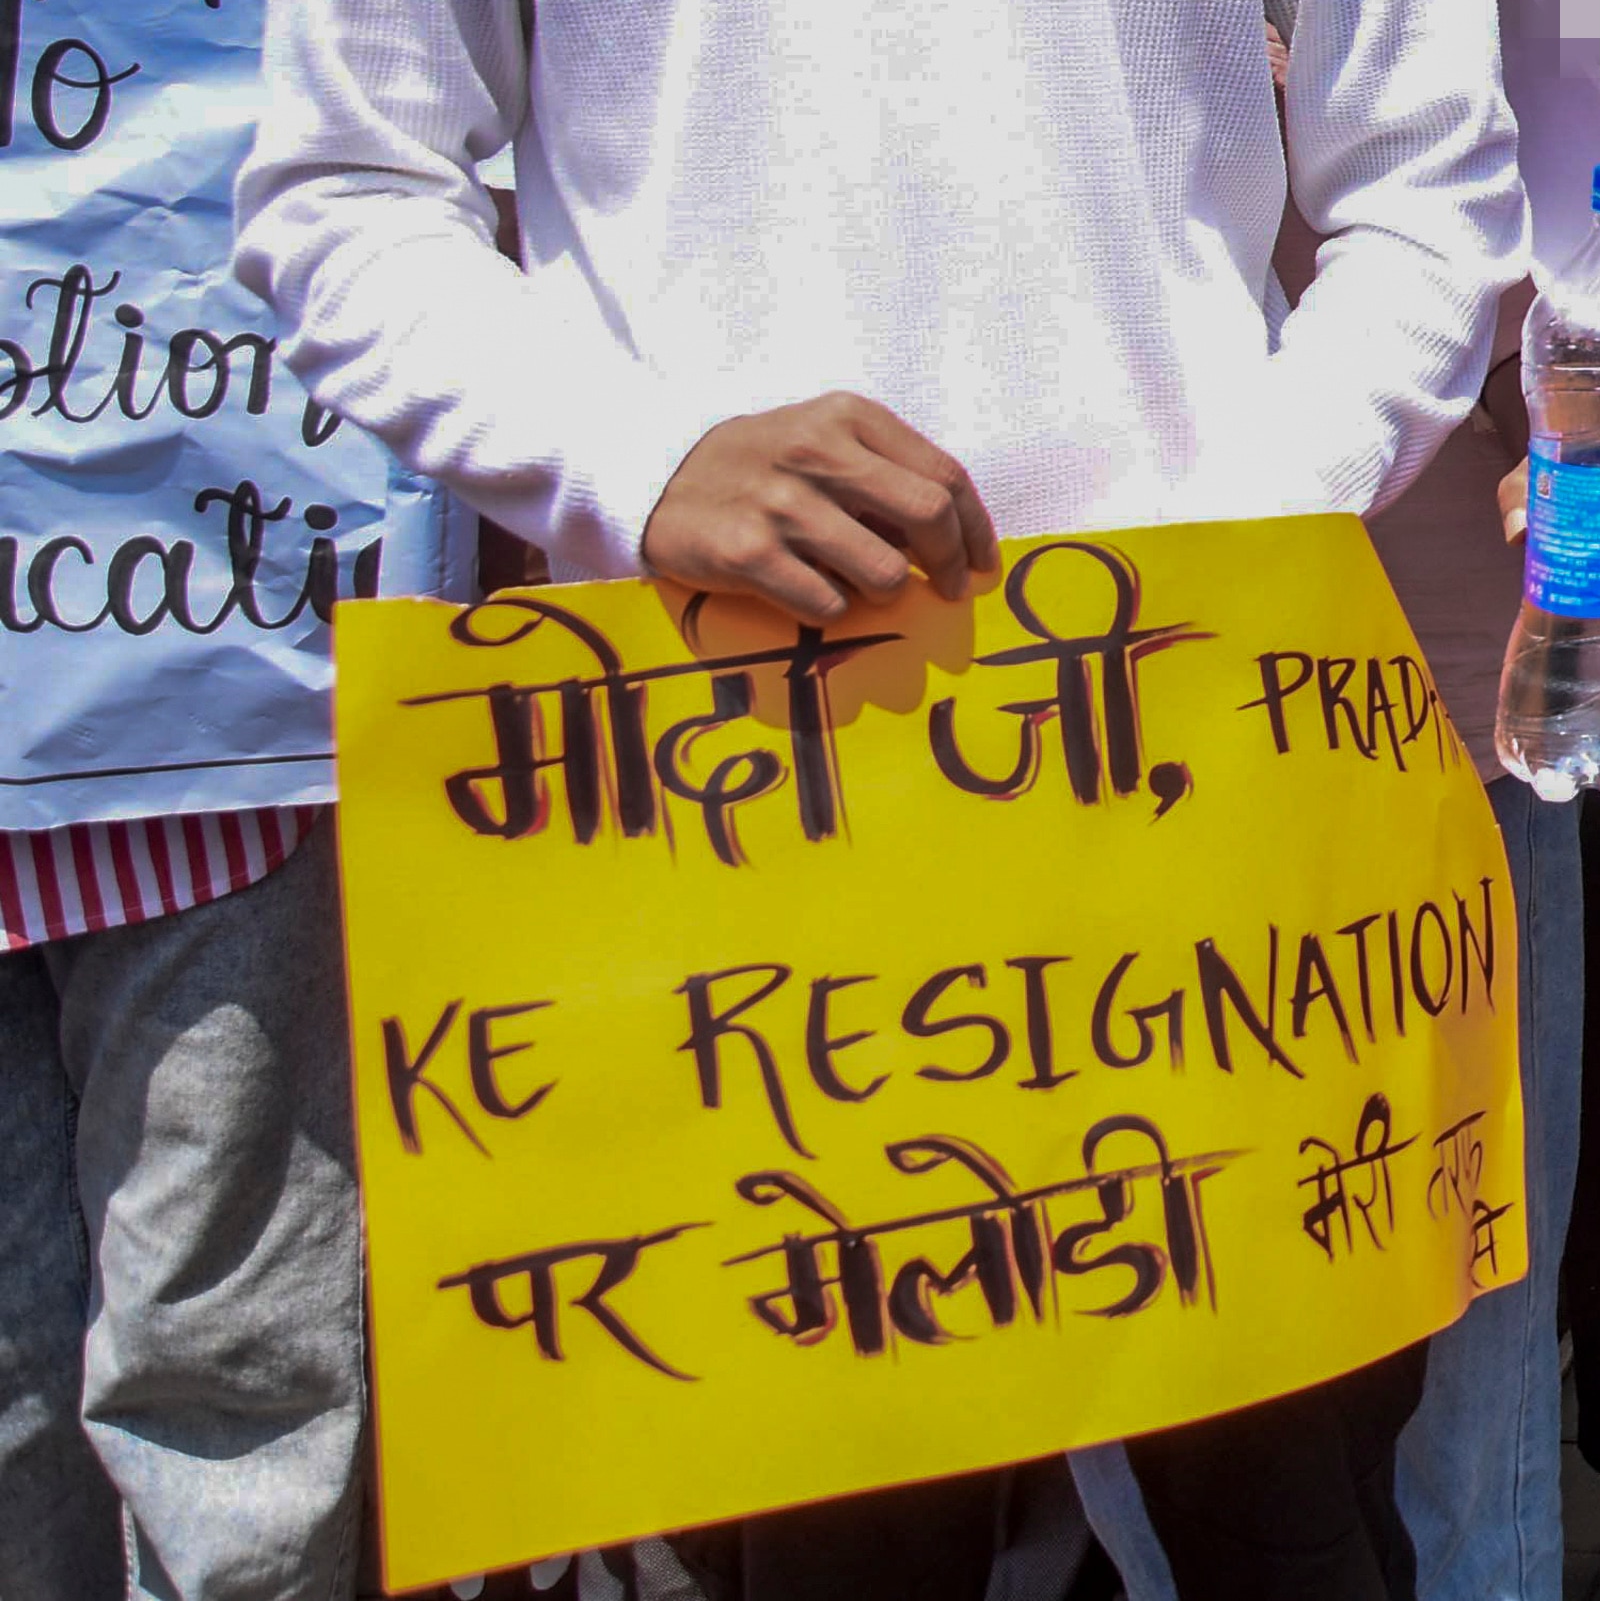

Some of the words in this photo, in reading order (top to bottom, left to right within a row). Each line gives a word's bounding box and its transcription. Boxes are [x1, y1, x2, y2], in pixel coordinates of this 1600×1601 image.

[379, 998, 558, 1158] KE
[675, 875, 1497, 1160] RESIGNATION
[435, 1219, 717, 1383] पर
[721, 1114, 1262, 1361] मेलोडी
